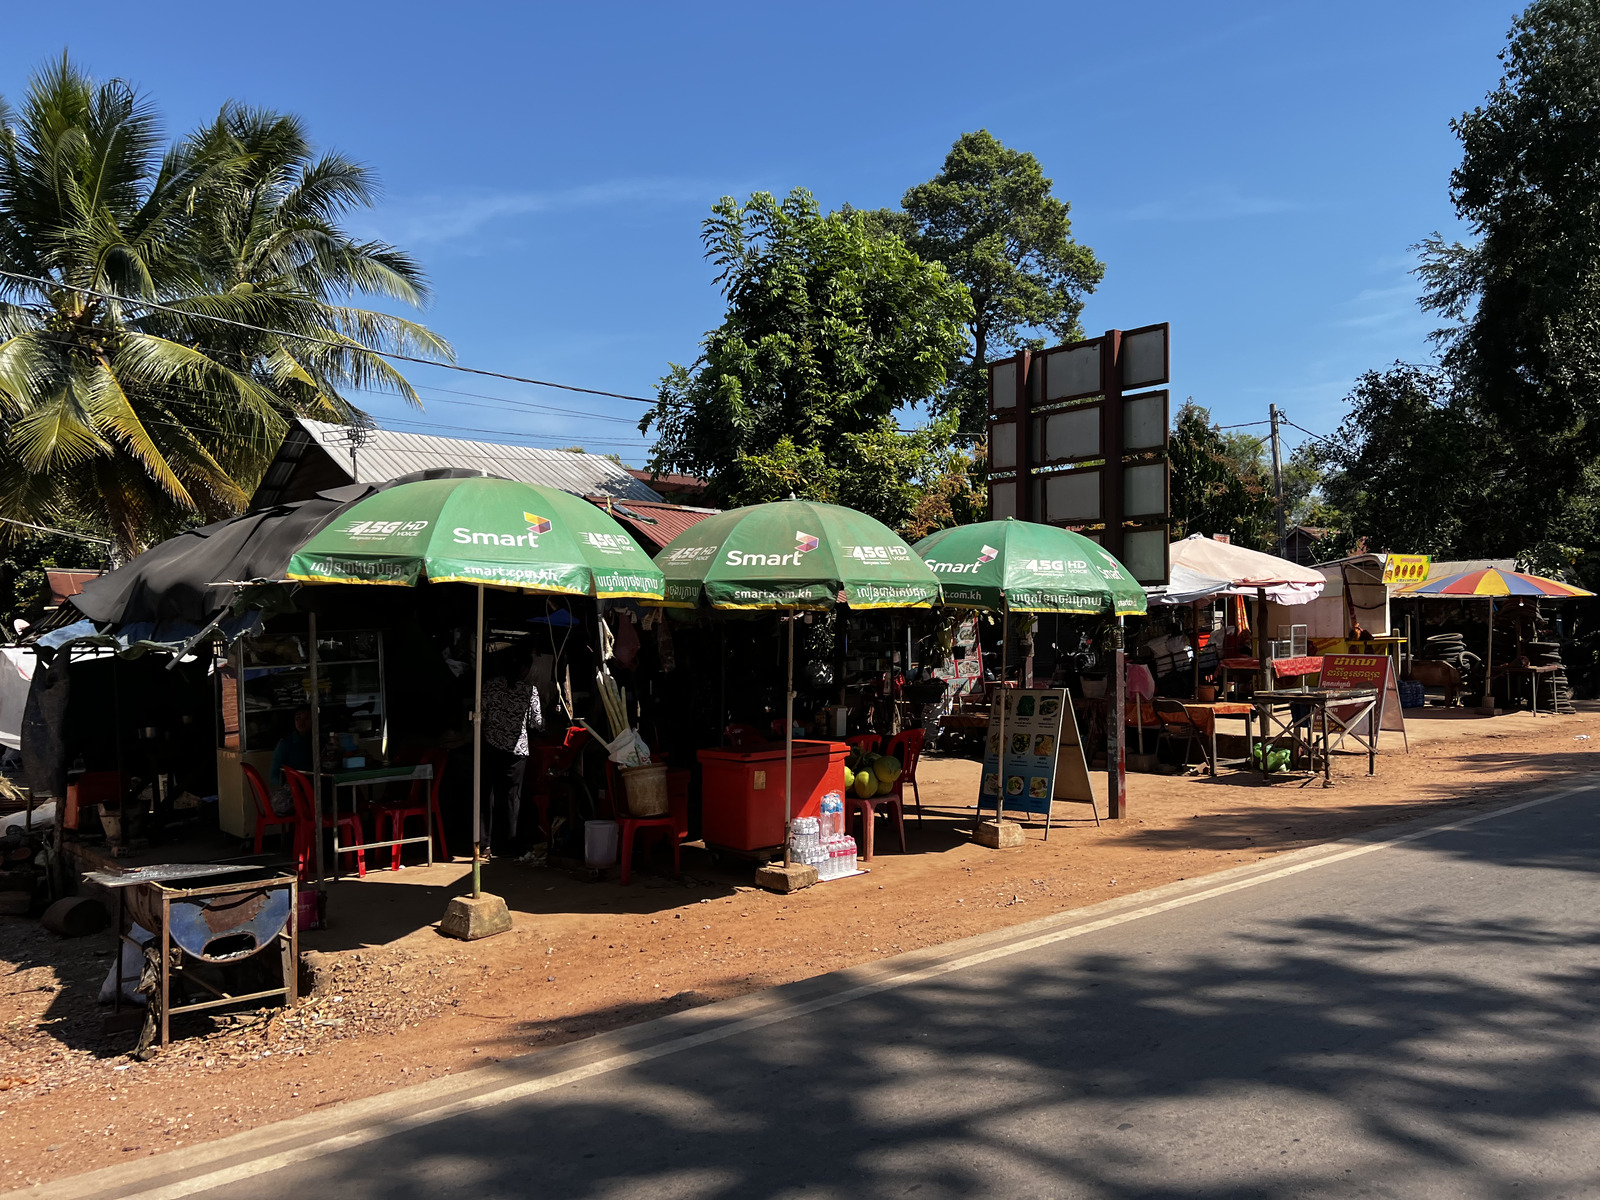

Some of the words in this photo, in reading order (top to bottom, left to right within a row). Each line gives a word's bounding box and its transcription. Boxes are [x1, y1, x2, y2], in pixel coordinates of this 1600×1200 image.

[401, 520, 429, 531] HD
[452, 527, 539, 548] Smart
[700, 546, 718, 556] HD
[887, 546, 908, 556] HD
[725, 550, 803, 567] Smart
[923, 559, 982, 574] Smart
[1025, 559, 1064, 573] 4.5G
[1067, 560, 1088, 569] HD
[734, 588, 813, 599] smart.com.kh
